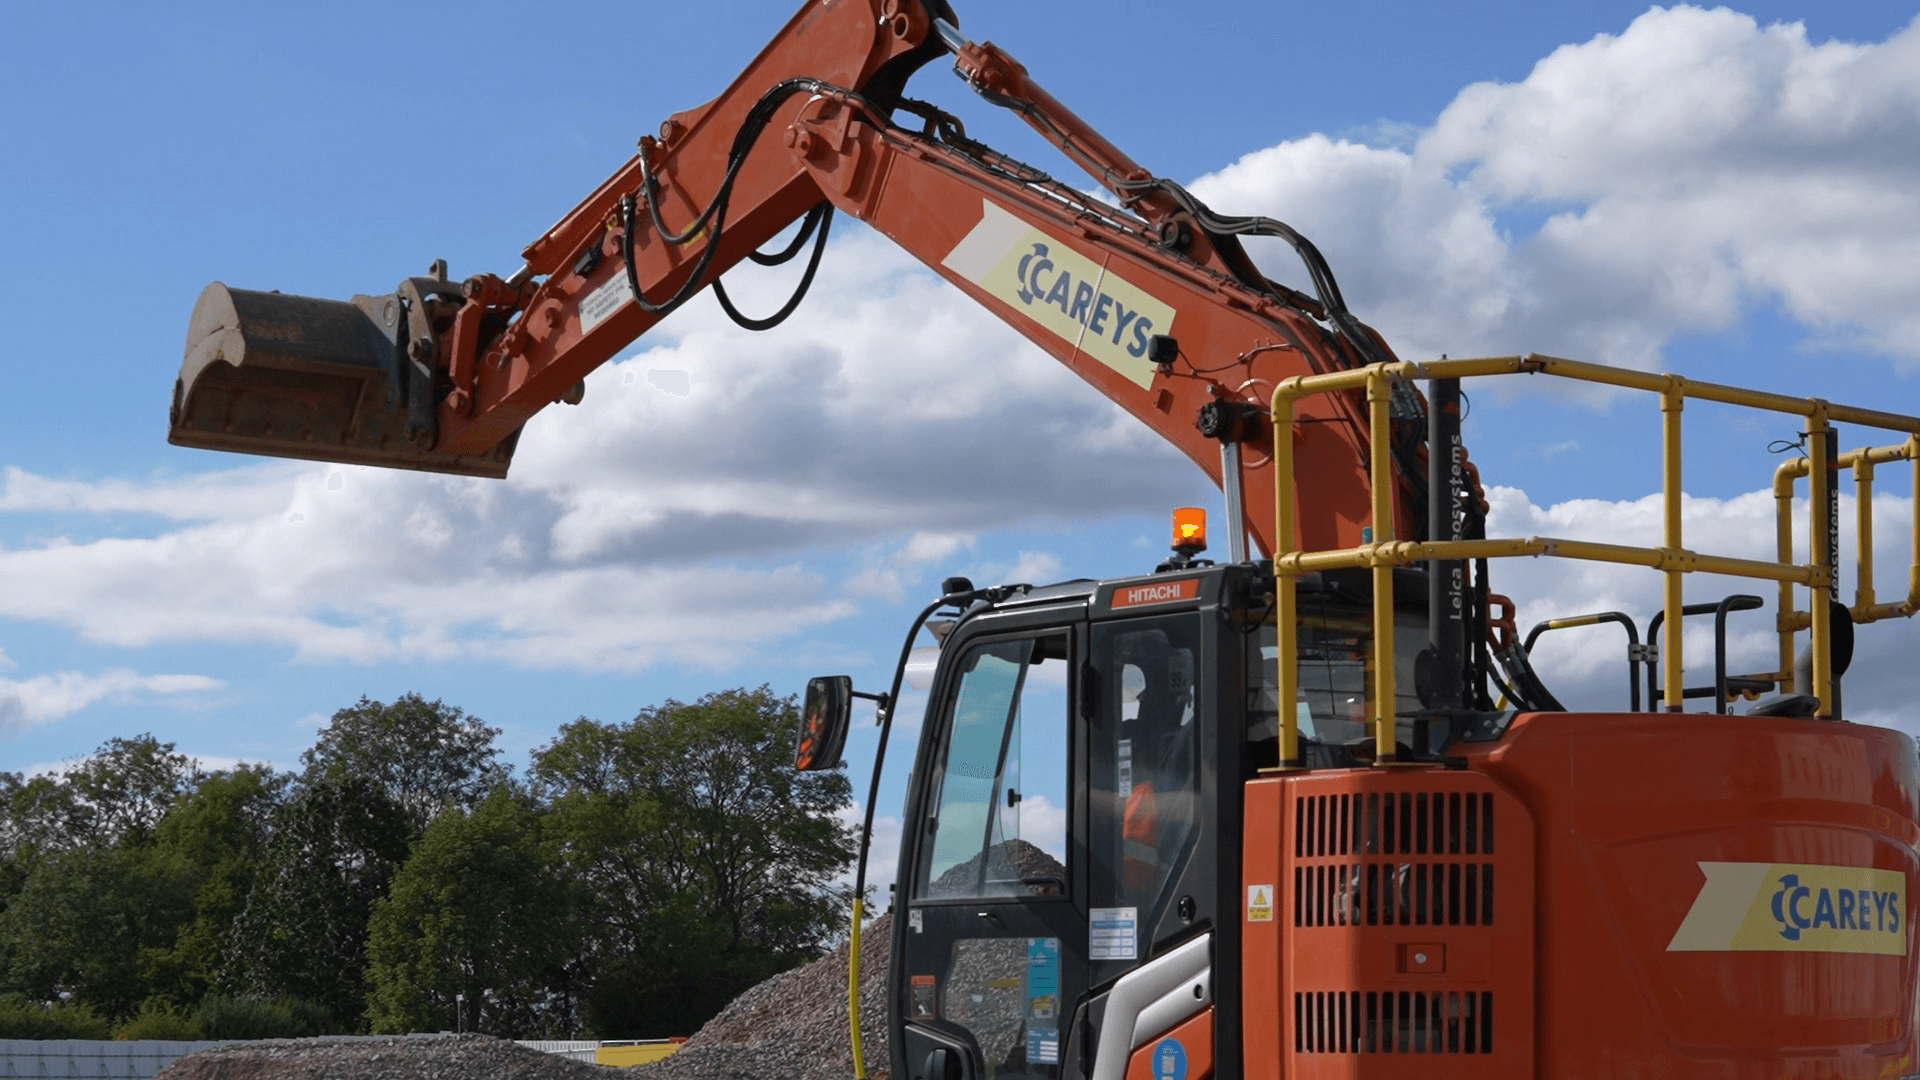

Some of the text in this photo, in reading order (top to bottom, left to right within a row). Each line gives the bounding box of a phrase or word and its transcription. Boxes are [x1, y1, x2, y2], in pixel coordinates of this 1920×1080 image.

[1030, 258, 1154, 358] CAREYS
[1449, 434, 1463, 620] Leica eosystems
[1128, 584, 1181, 603] HITACHI
[1788, 885, 1900, 934] CAREYS
